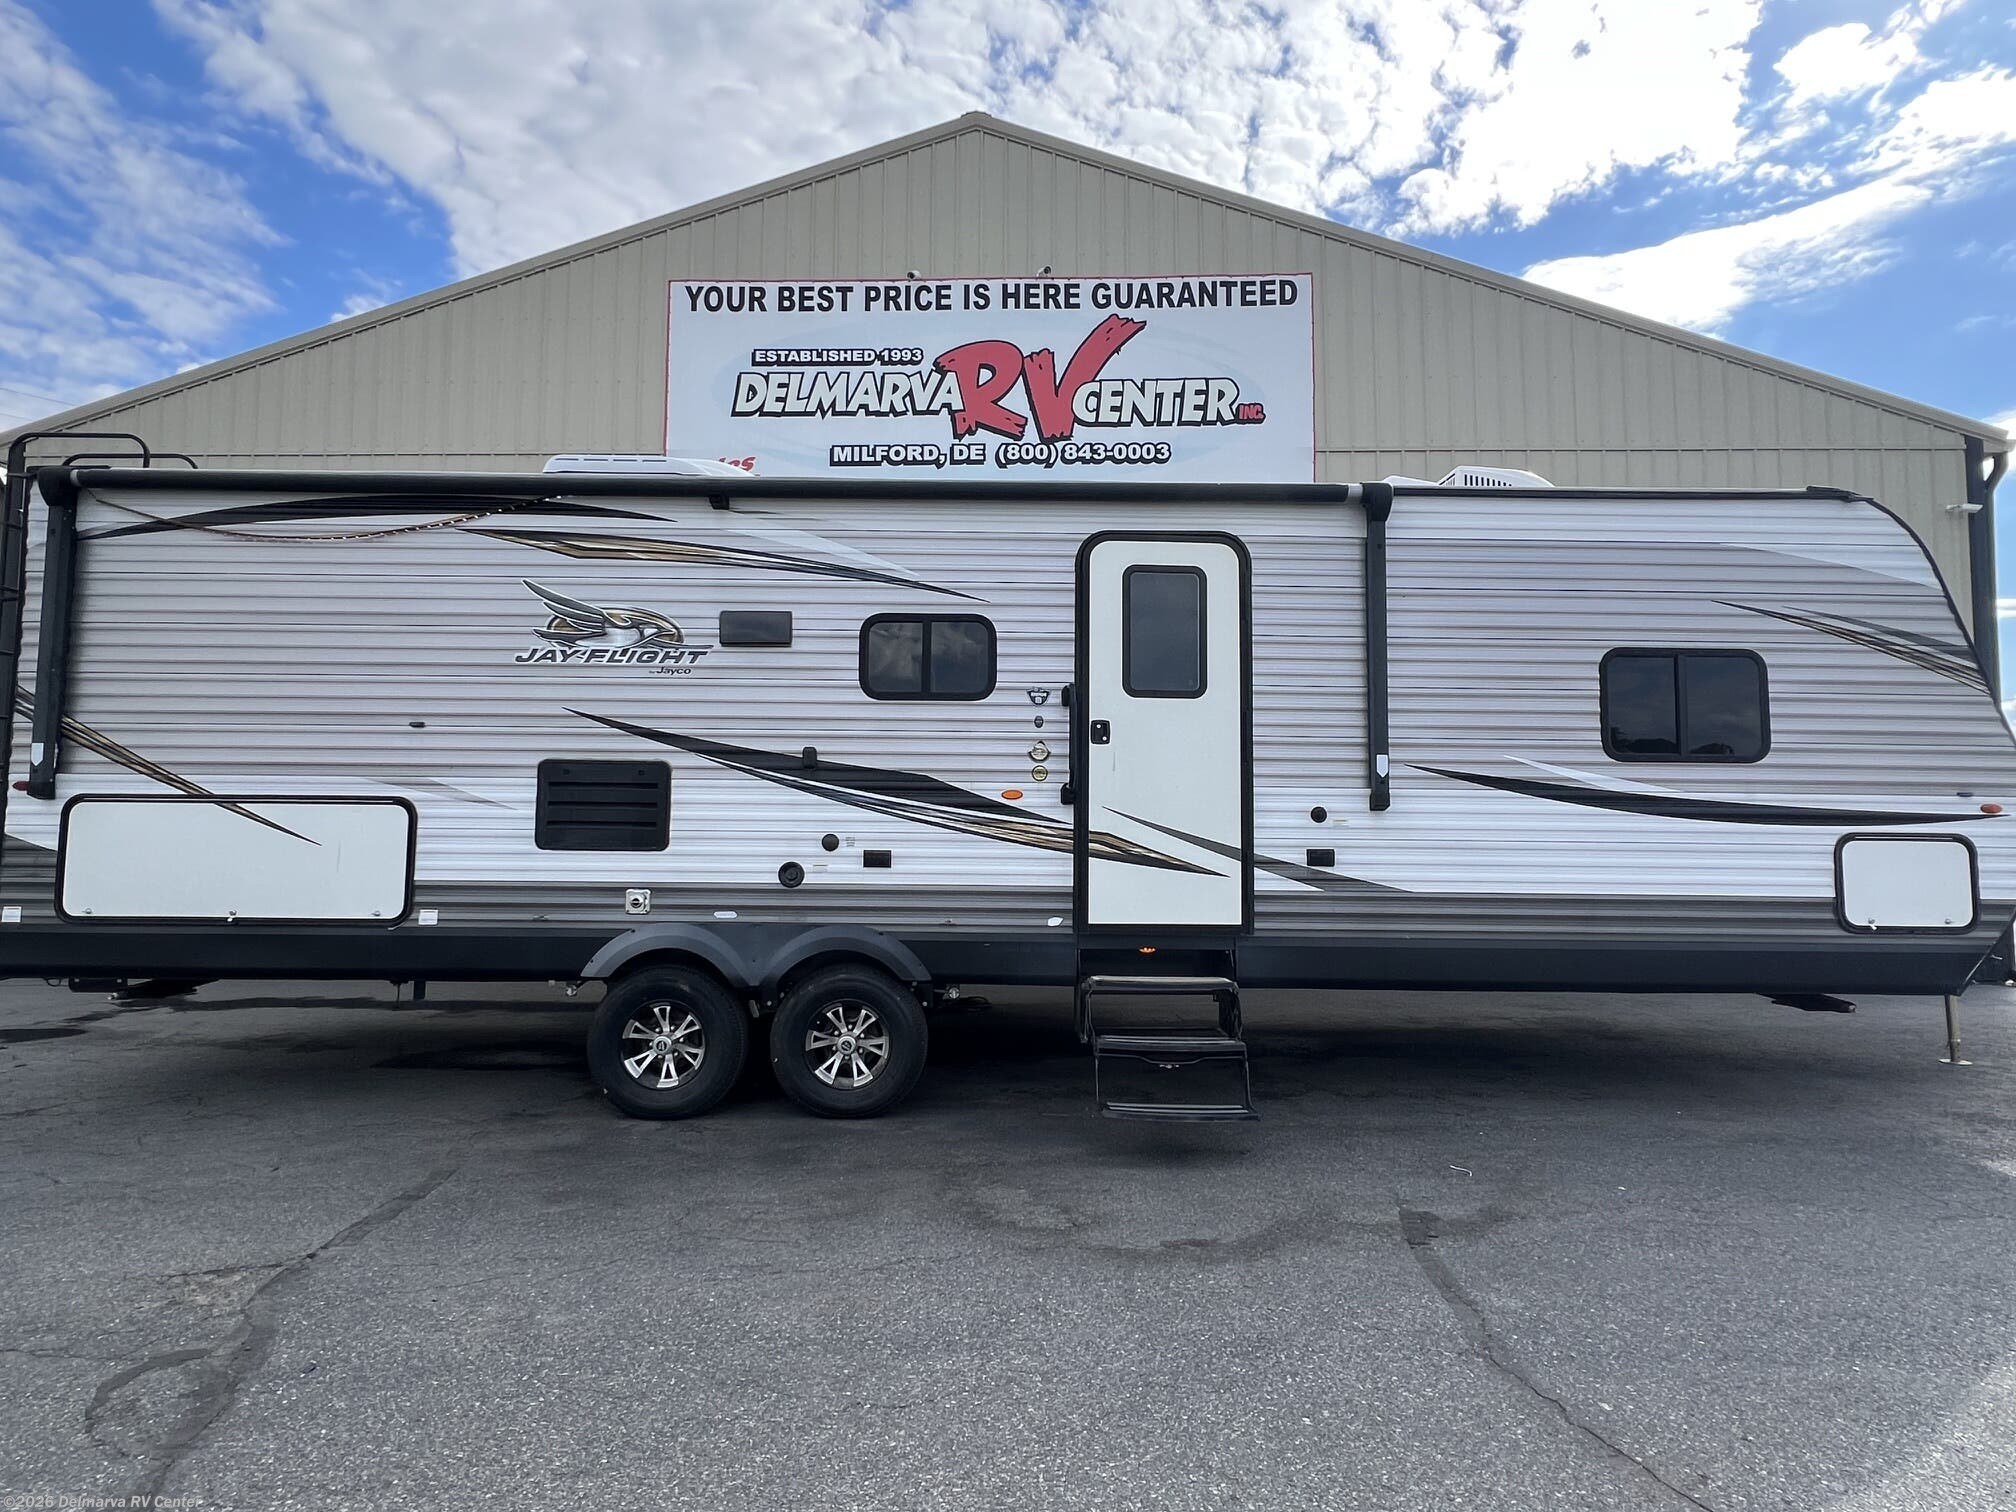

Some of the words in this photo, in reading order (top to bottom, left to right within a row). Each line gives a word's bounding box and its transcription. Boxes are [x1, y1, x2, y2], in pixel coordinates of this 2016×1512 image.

[685, 285, 767, 312] YOUR
[777, 286, 853, 312] BEST
[864, 285, 951, 312] PRICE
[963, 284, 991, 310] IS
[1001, 283, 1081, 310] HERE
[1091, 279, 1298, 310] GUARANTEED
[753, 348, 878, 365] ESTABLISHED
[881, 348, 924, 364] 1993
[731, 370, 966, 418] DELMARVA
[934, 314, 1147, 443] RV
[1071, 377, 1241, 426] CENTER
[1235, 403, 1266, 424] INC.
[832, 444, 947, 467] MILFORD,
[952, 444, 986, 466] DE
[996, 443, 1057, 467] (800)
[1062, 442, 1173, 464] 843-0003
[656, 667, 692, 676] Jayco
